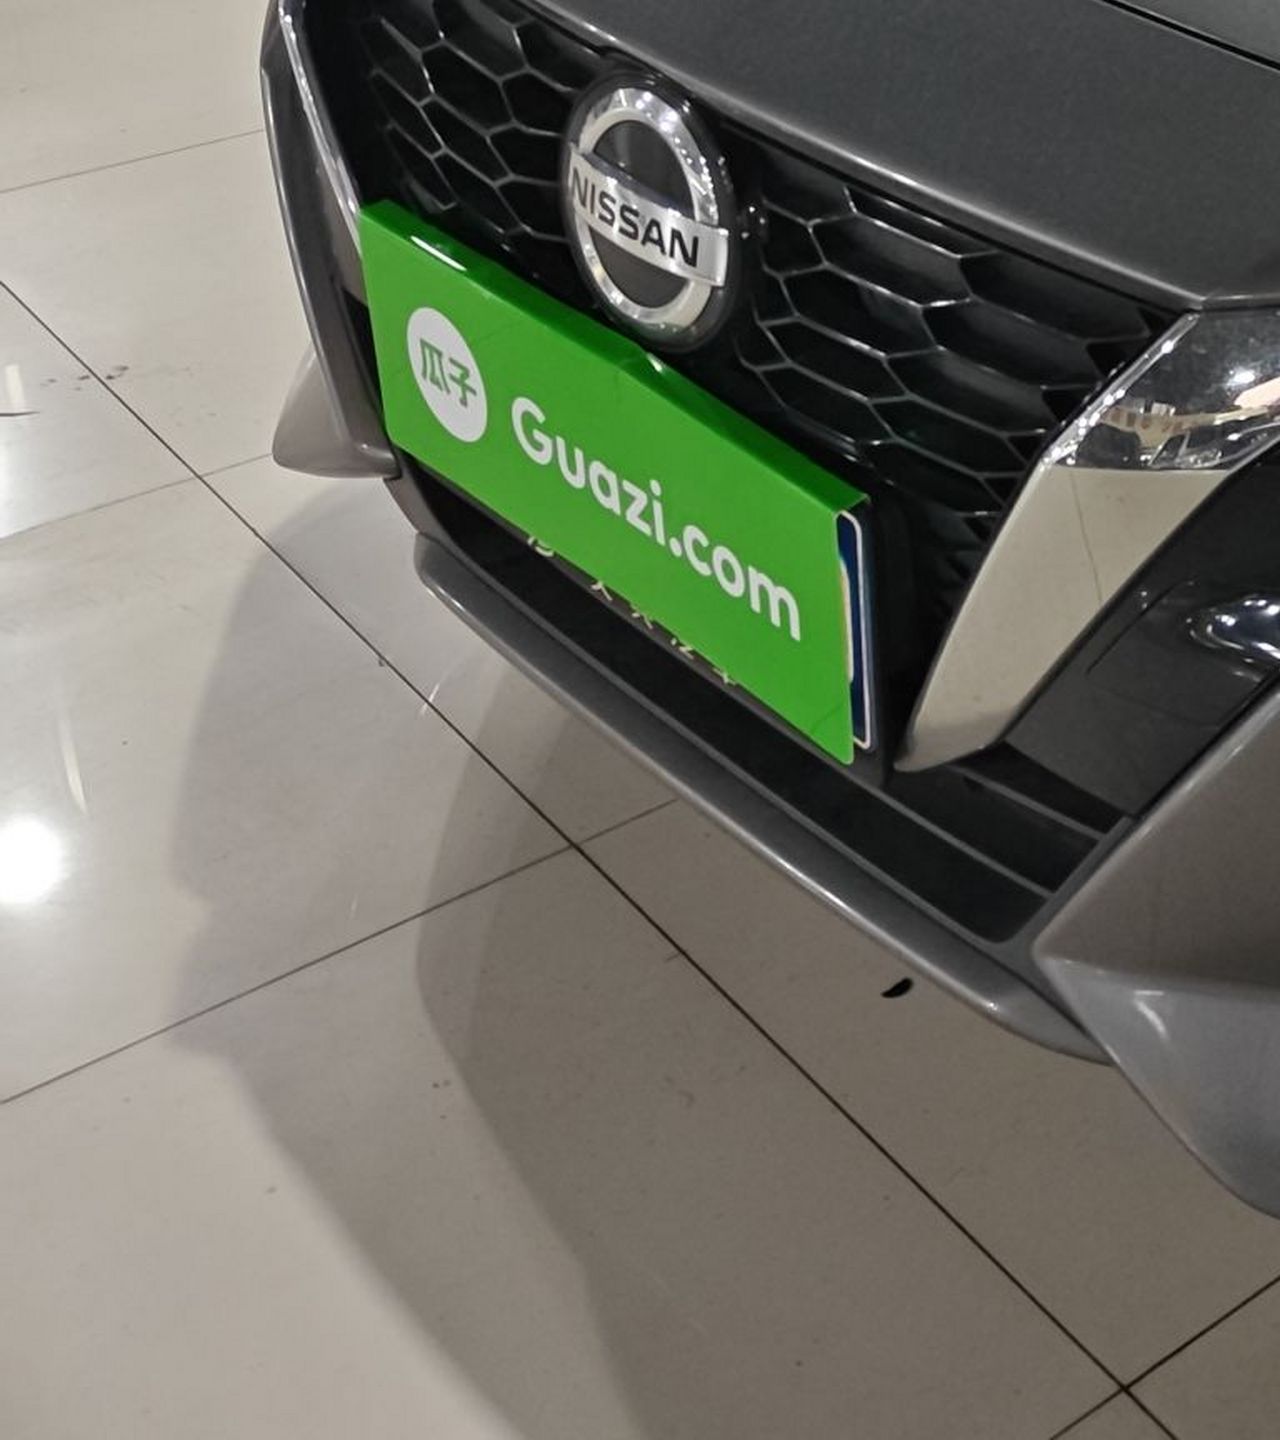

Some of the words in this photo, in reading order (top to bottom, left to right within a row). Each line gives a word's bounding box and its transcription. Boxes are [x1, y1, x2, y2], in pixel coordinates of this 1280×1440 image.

[571, 167, 699, 268] NISSAN
[420, 338, 477, 408] 瓜子
[511, 396, 801, 641] Guazi.com
